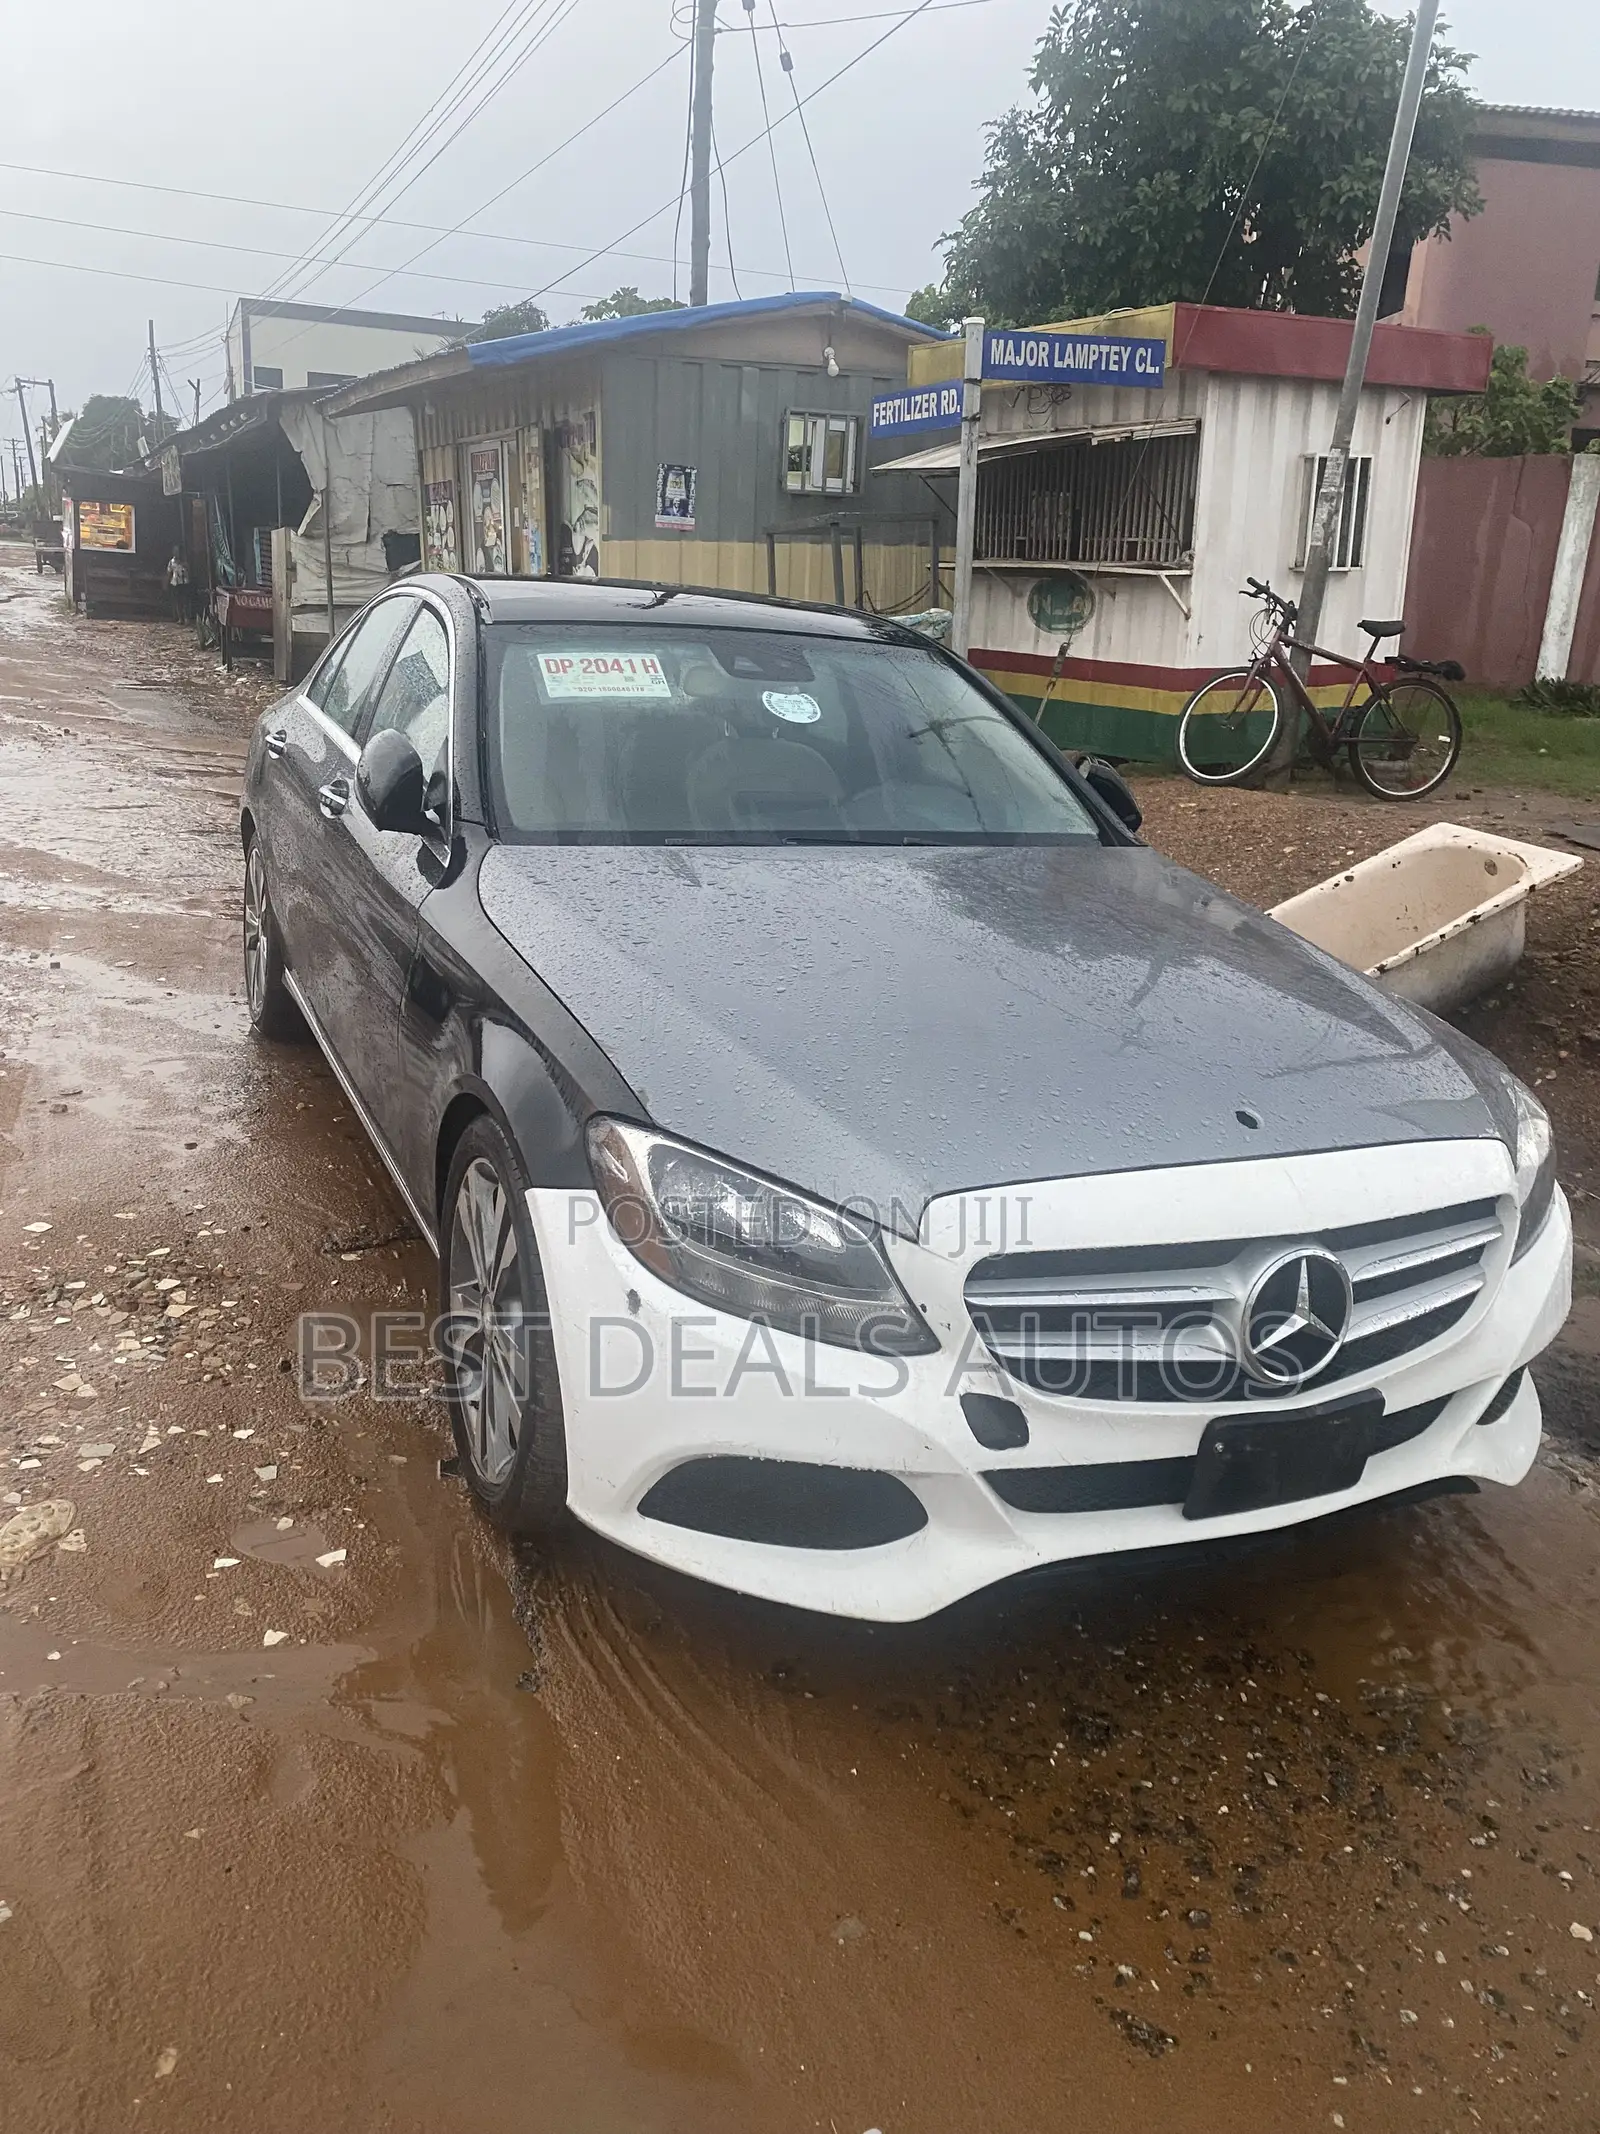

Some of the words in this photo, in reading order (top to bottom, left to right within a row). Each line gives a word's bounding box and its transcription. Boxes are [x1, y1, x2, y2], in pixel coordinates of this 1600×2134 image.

[990, 338, 1049, 367] MAJOR
[1053, 342, 1132, 372] LAMPTEY
[1135, 347, 1160, 374] CL.
[873, 392, 937, 427] FERTILIZER
[941, 388, 961, 416] RD.
[543, 658, 574, 674] DP
[580, 658, 637, 674] 2041
[641, 658, 660, 674] H
